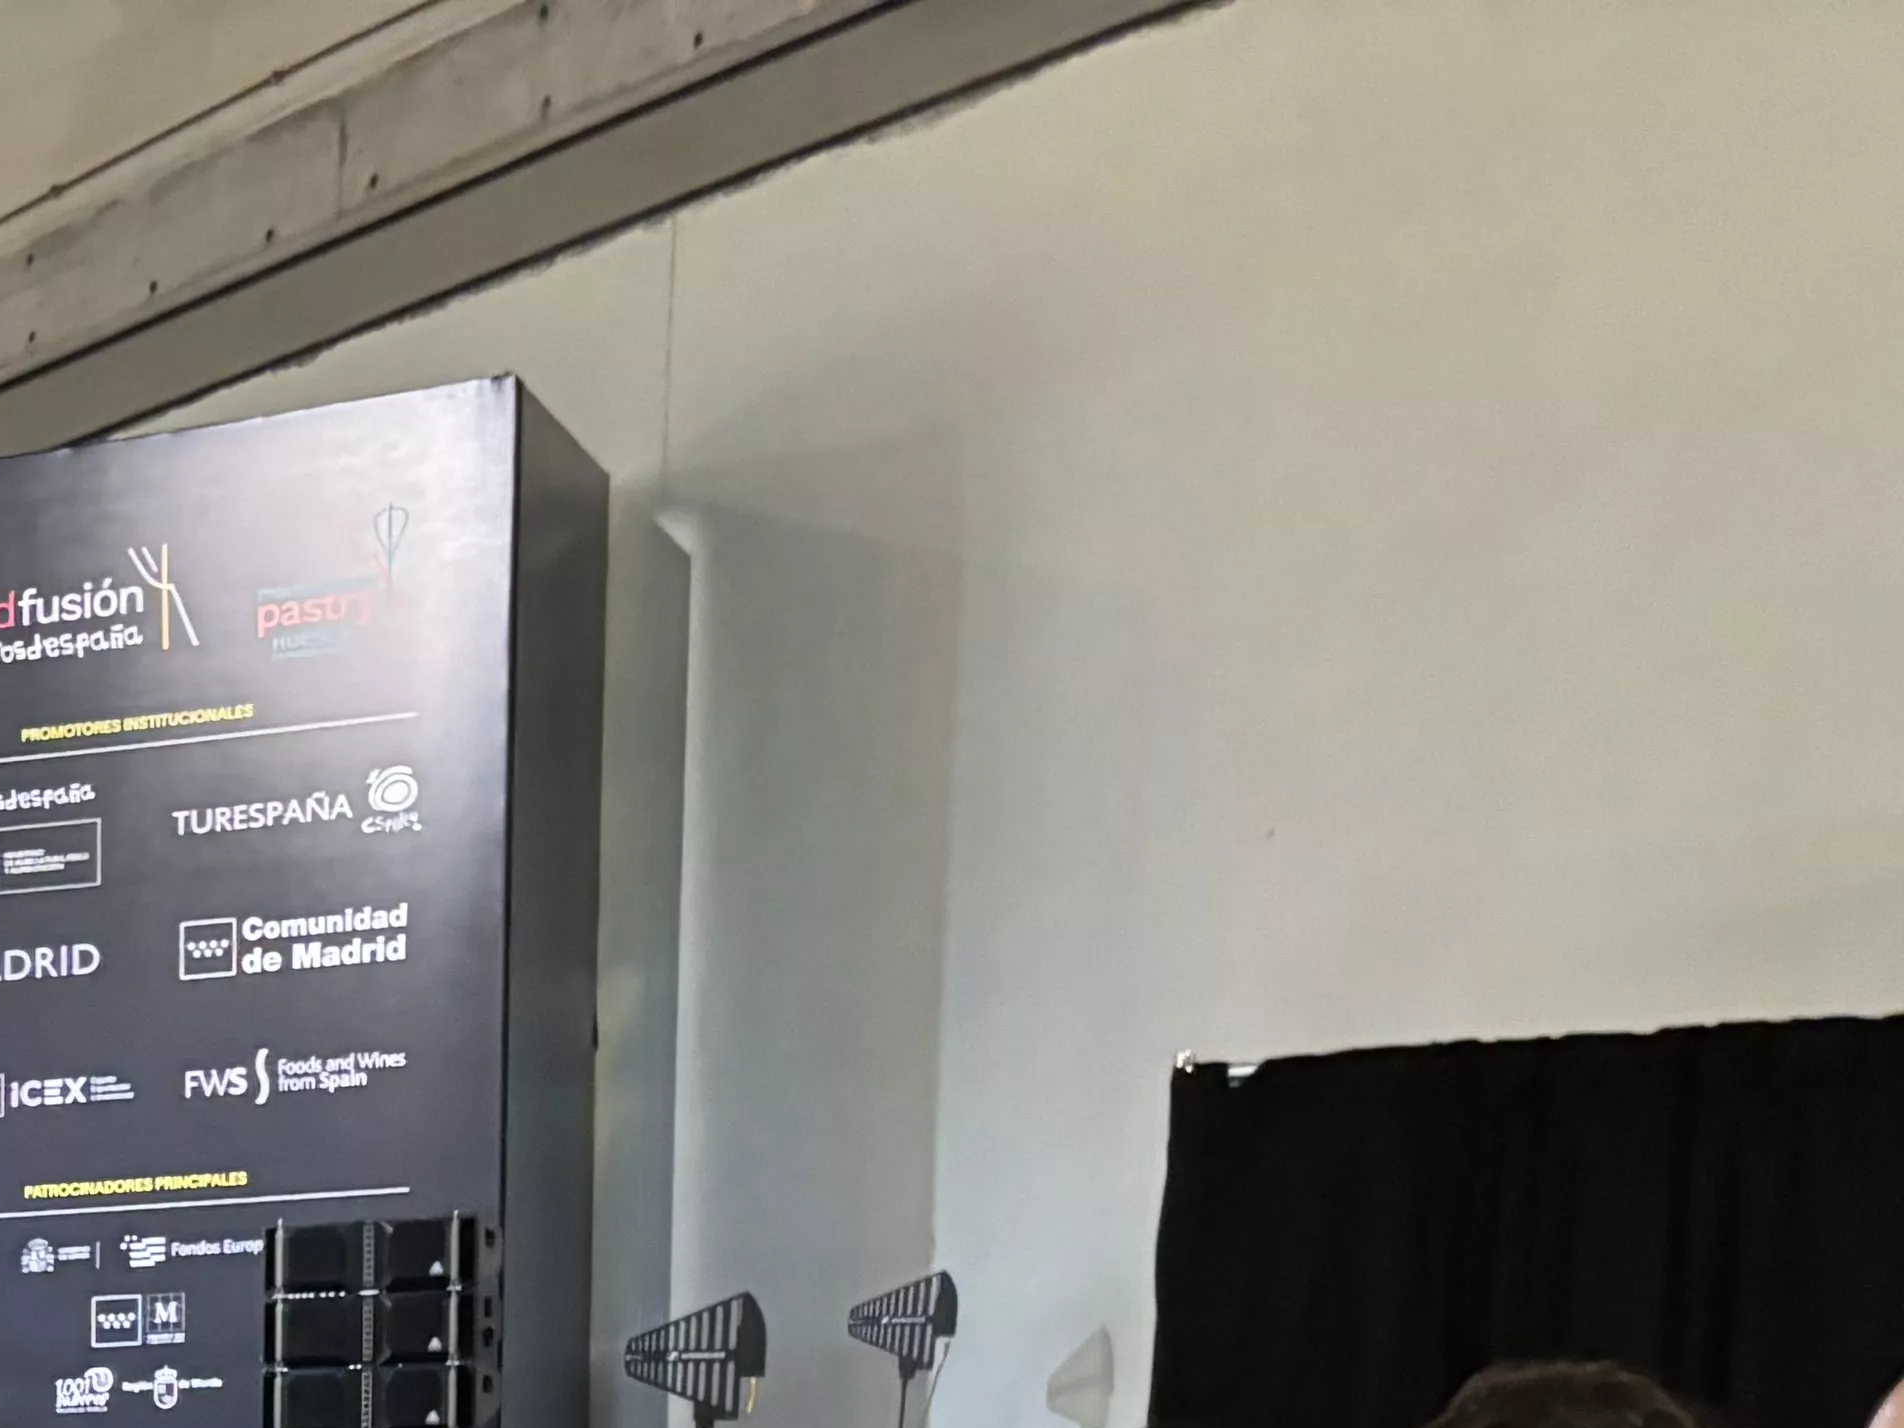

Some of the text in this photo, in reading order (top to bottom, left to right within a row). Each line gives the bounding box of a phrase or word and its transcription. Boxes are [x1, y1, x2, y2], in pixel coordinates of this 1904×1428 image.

[21, 703, 254, 742] PROMOTORES INSTITUCIONALES
[172, 791, 353, 836] TURESPAÑA
[242, 902, 409, 940] Comunidad
[242, 933, 406, 974] de Madrid
[277, 1051, 407, 1076] Foods and Wines
[10, 1076, 87, 1108] ICEX
[185, 1067, 248, 1098] FWS
[278, 1071, 368, 1093] from Spain
[24, 1171, 248, 1199] PATROCINADORES PRINCIPALES
[171, 1241, 221, 1257] Fondos
